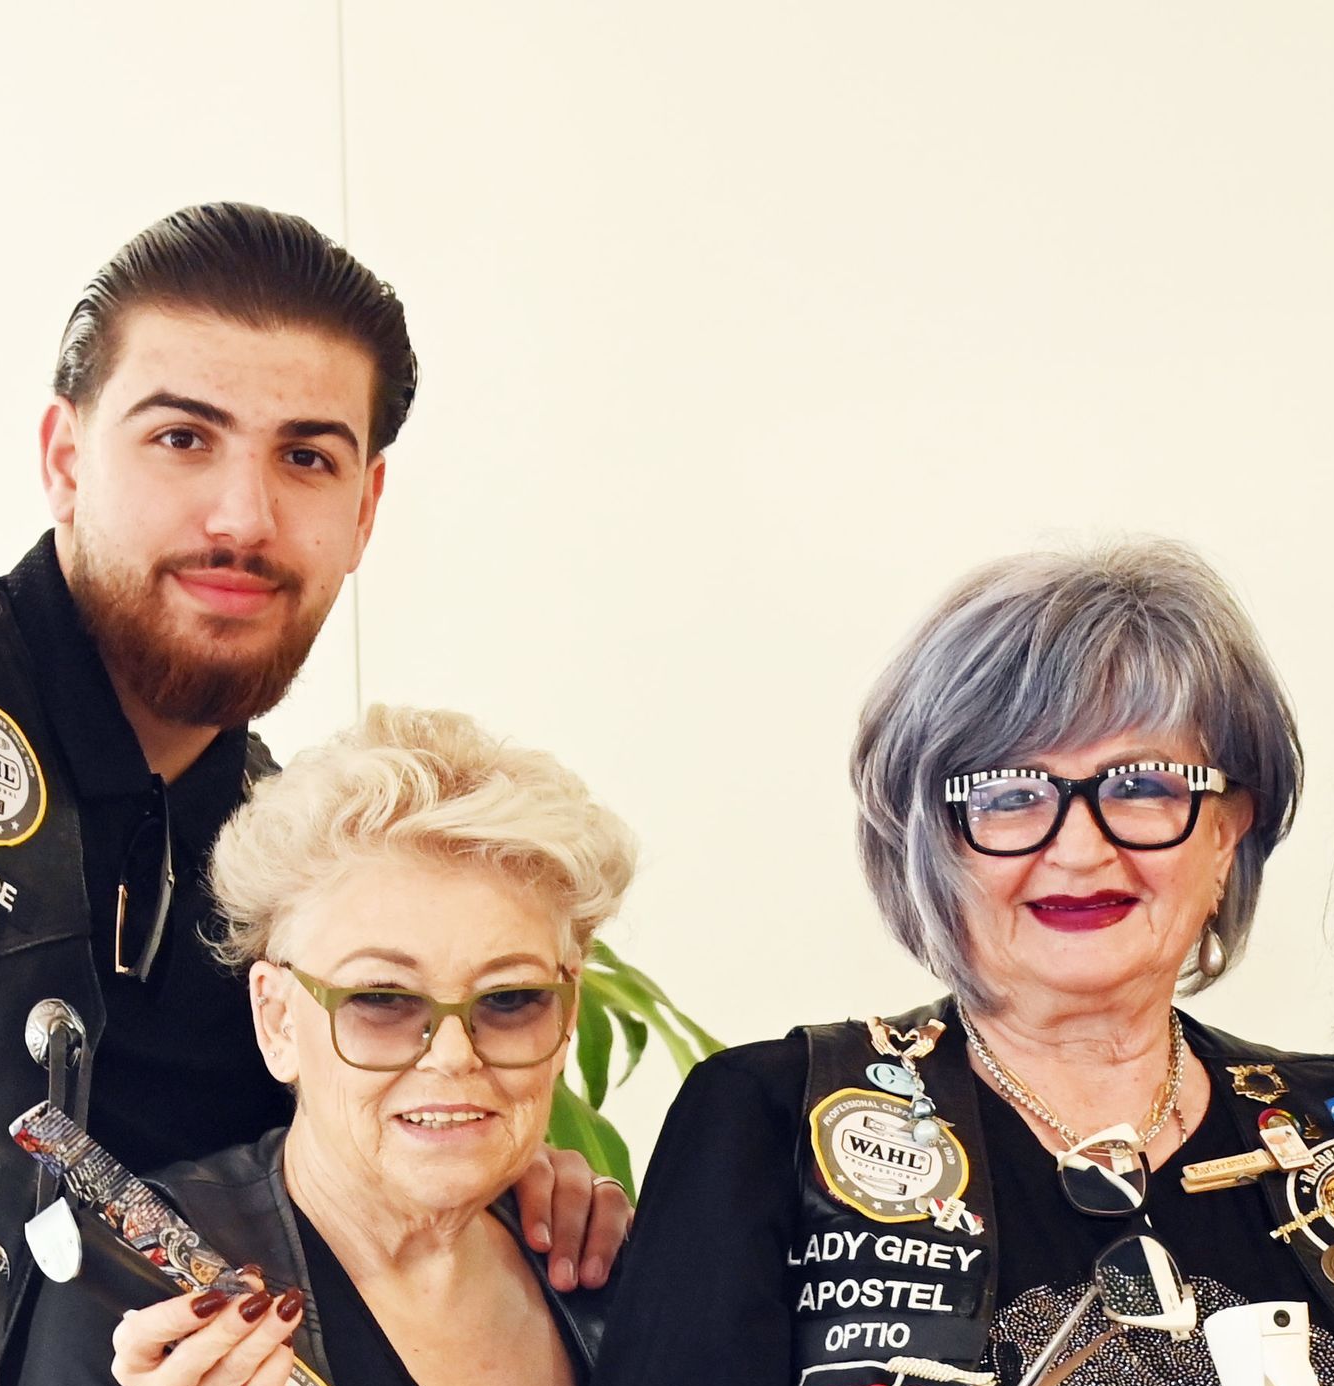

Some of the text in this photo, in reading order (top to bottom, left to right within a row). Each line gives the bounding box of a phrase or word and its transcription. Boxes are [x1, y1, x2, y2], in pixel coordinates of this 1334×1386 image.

[823, 1099, 913, 1127] PROFESSIONAL CLIPP
[849, 1134, 923, 1170] WAHL
[844, 1155, 924, 1183] PROFESSIONAL
[787, 1229, 983, 1273] LADY GREY
[797, 1277, 954, 1313] APOSTEL
[824, 1322, 912, 1352] OPTIO
